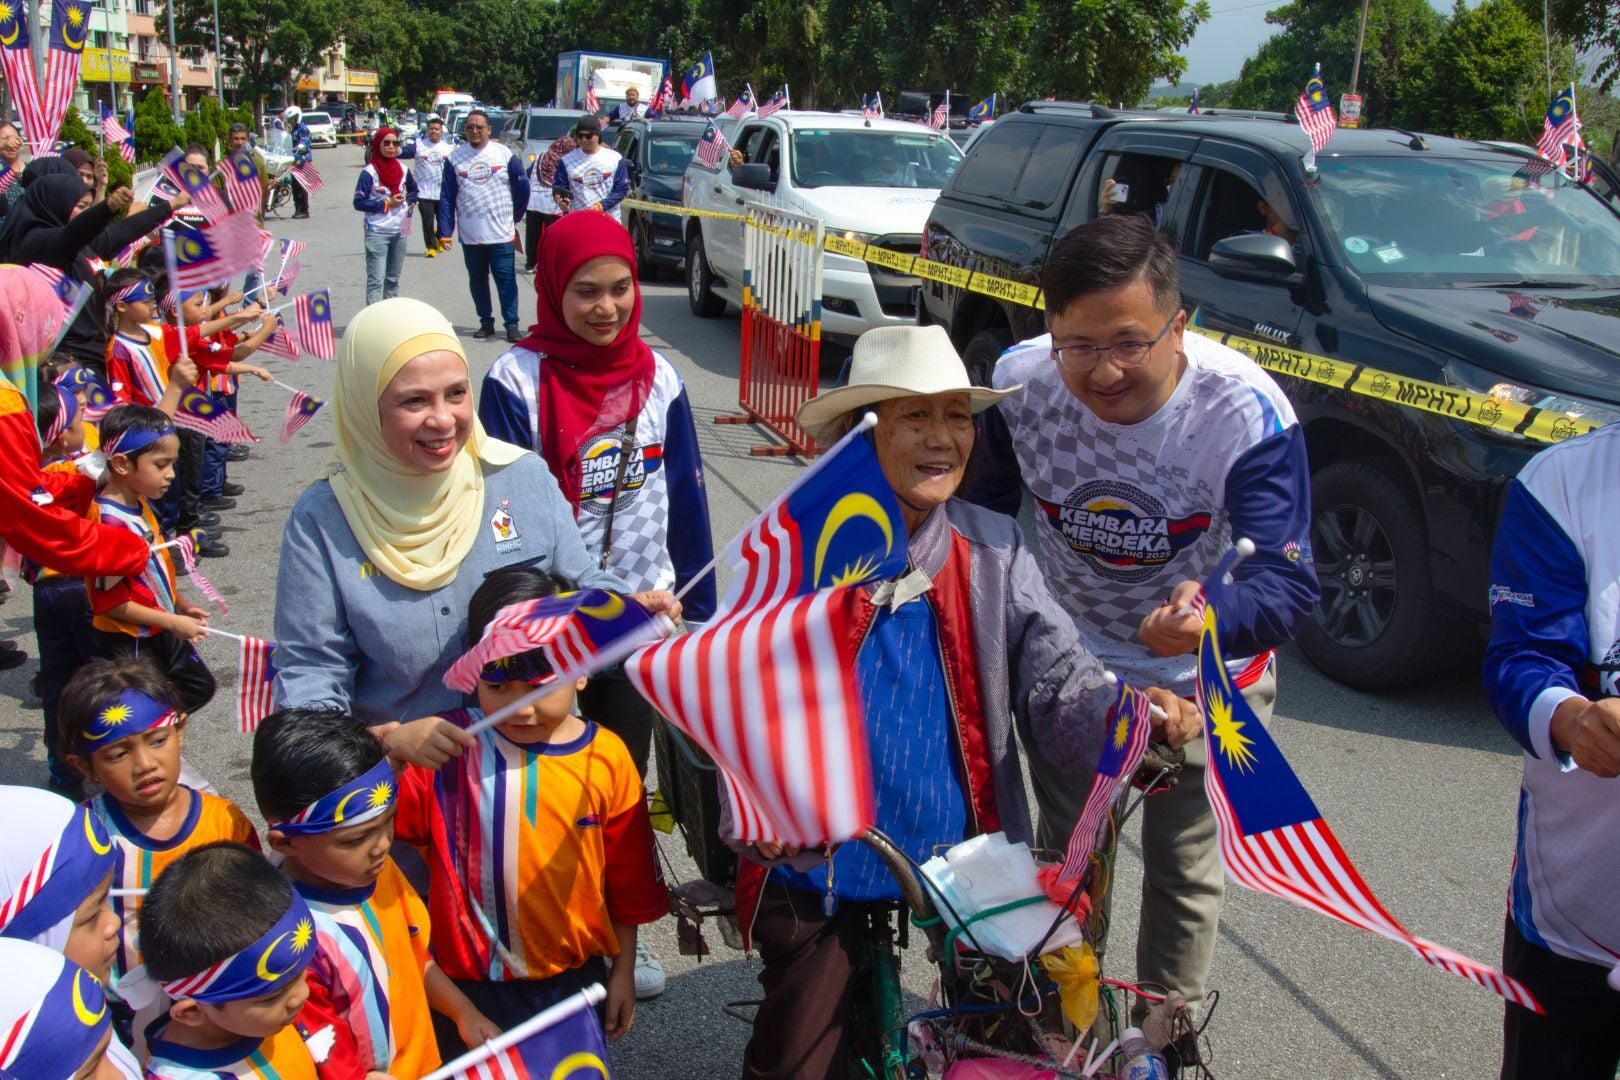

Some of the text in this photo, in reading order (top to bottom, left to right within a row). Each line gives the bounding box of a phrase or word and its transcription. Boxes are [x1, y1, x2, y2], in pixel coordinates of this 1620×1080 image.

[835, 239, 854, 252] MPHTJ
[878, 250, 899, 267] MPHTJ
[927, 263, 953, 282] MPHTJ
[986, 278, 1017, 300] MPHTJ
[1254, 323, 1292, 345] HILUX
[1254, 345, 1313, 377] MPHTJ
[1395, 380, 1471, 418] MPHTJ
[581, 448, 644, 473] EMBAA
[581, 461, 645, 488] ERDKA
[594, 477, 628, 492] GEMILG
[629, 474, 644, 483] 2025
[1058, 506, 1169, 536] KEMBARA
[496, 540, 522, 552] RMHC
[1062, 521, 1171, 551] MERDEKA
[1066, 537, 1171, 559] ALUR GEMILANG 2025
